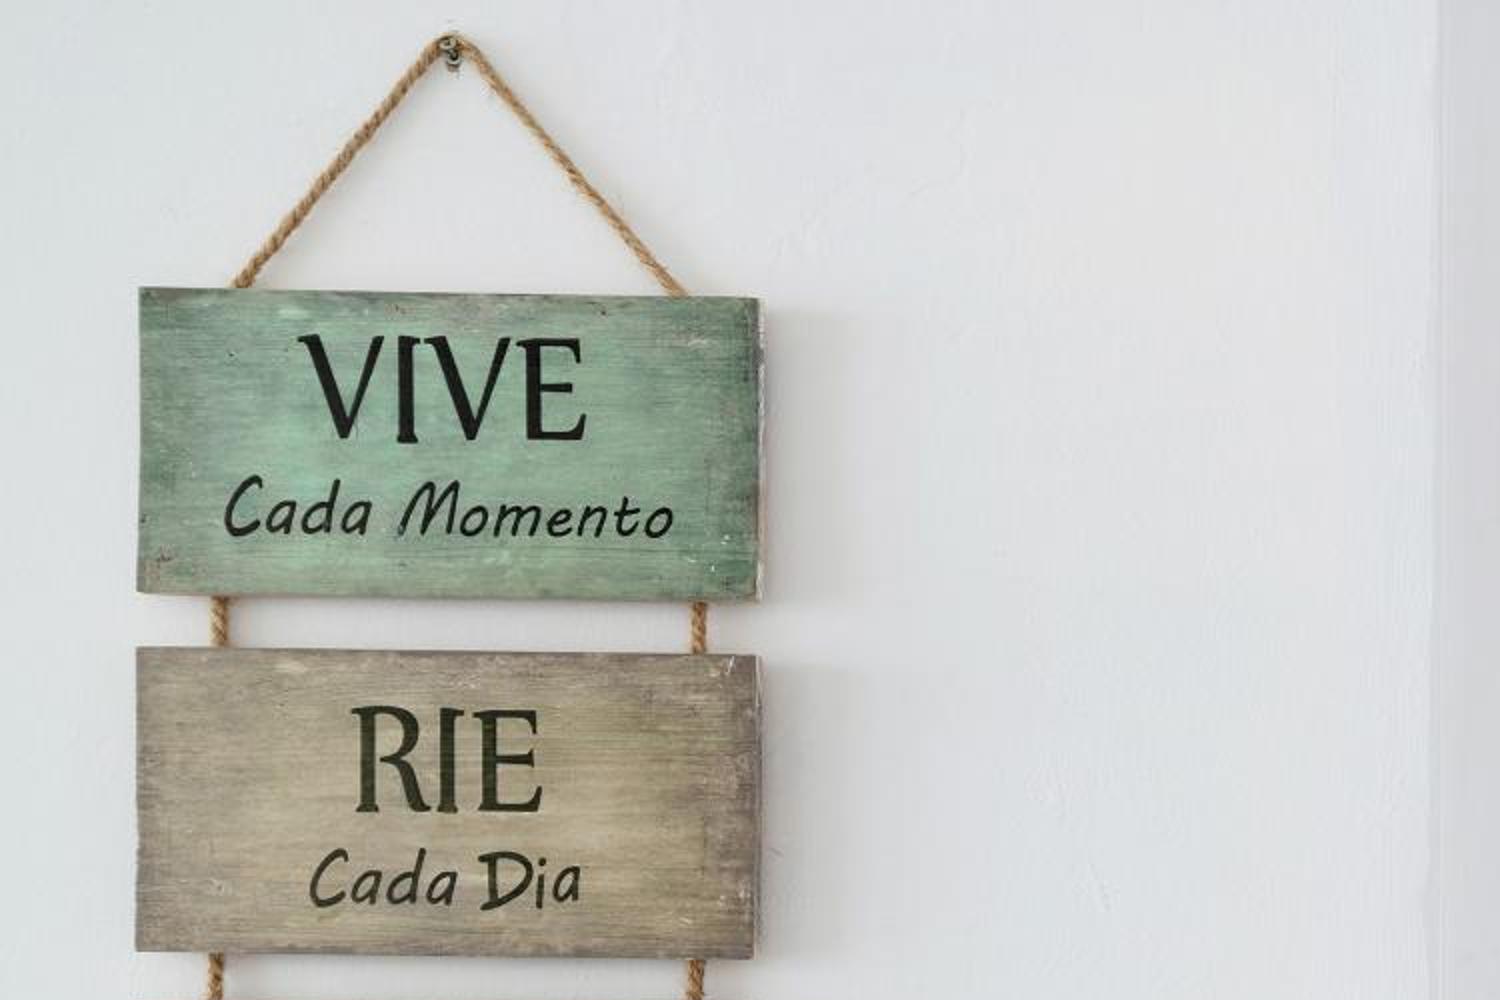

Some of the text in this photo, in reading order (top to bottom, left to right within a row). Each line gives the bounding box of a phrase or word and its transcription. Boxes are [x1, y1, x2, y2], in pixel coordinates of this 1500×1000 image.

[297, 334, 587, 444] VIVE
[224, 475, 674, 539] Cada Momento
[351, 705, 542, 813] RIE
[309, 847, 582, 911] Cada Dia
